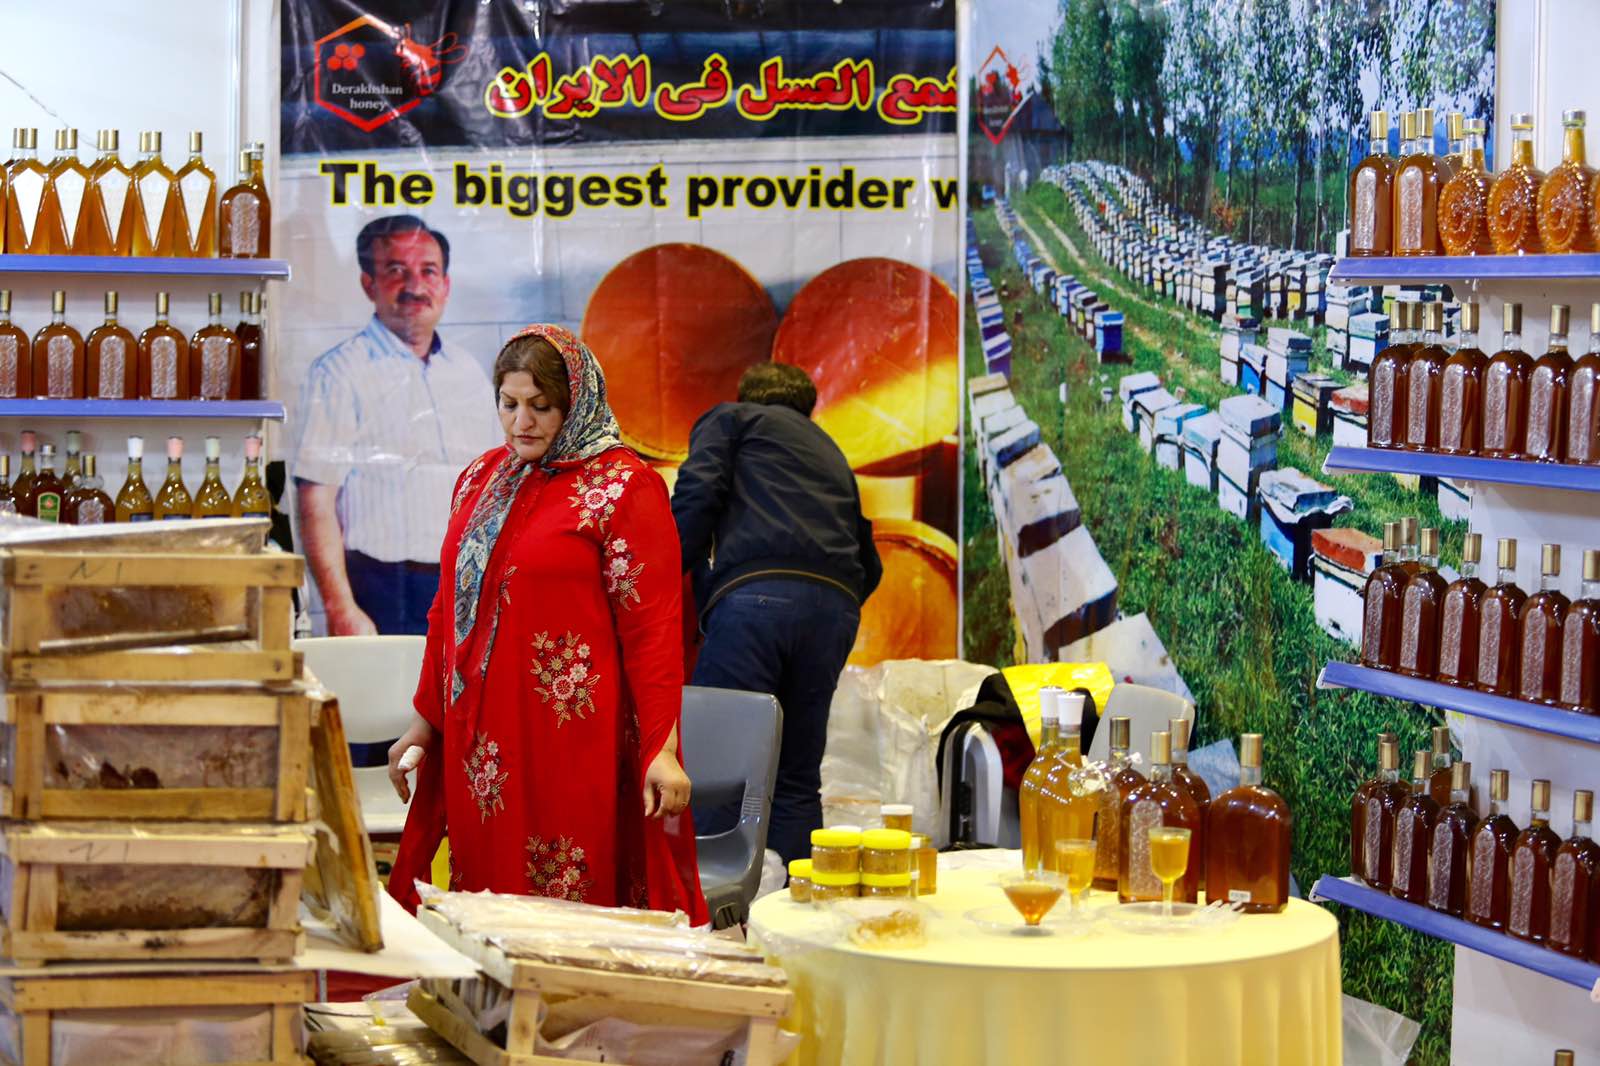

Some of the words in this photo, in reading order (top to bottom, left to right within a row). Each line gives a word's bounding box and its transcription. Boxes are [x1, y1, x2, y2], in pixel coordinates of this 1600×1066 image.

[331, 82, 403, 95] Derakhshan
[349, 97, 386, 112] honey
[738, 56, 873, 119] العسل
[320, 160, 433, 207] The
[455, 160, 668, 217] biggest
[688, 167, 914, 219] provider
